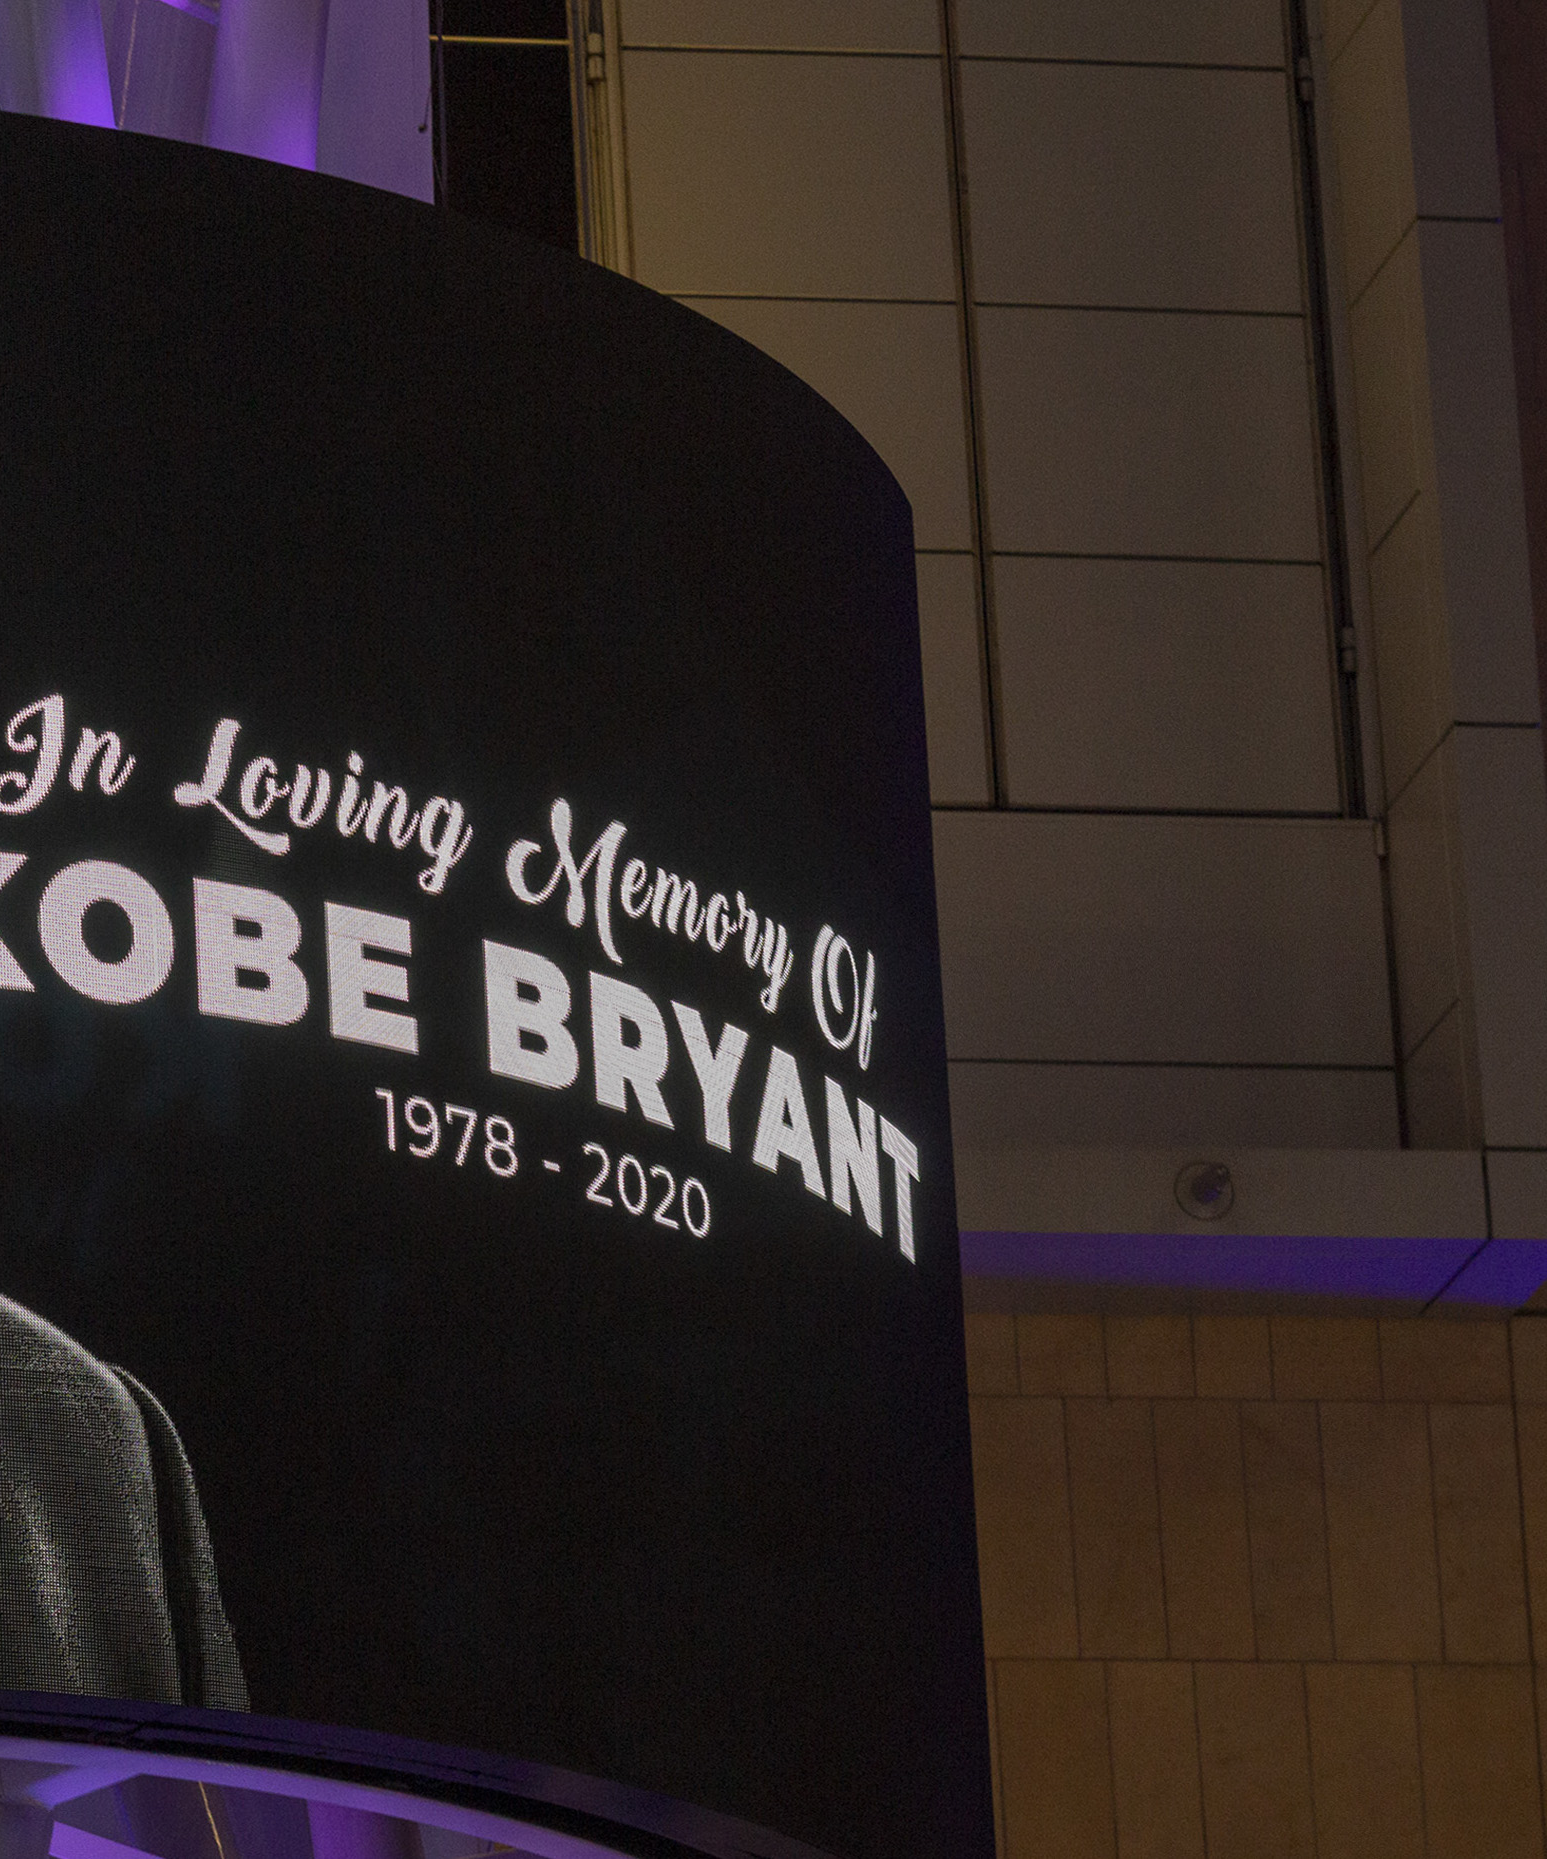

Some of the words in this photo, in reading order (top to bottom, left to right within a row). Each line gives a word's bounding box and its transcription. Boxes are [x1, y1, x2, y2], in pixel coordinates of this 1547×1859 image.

[173, 717, 473, 895] Loving
[505, 797, 795, 1014] Memory
[810, 923, 878, 1071] Of
[374, 1087, 519, 1178] 1978
[542, 1159, 561, 1173] -
[582, 1141, 712, 1239] 2020
[482, 938, 921, 1265] BRYANT
